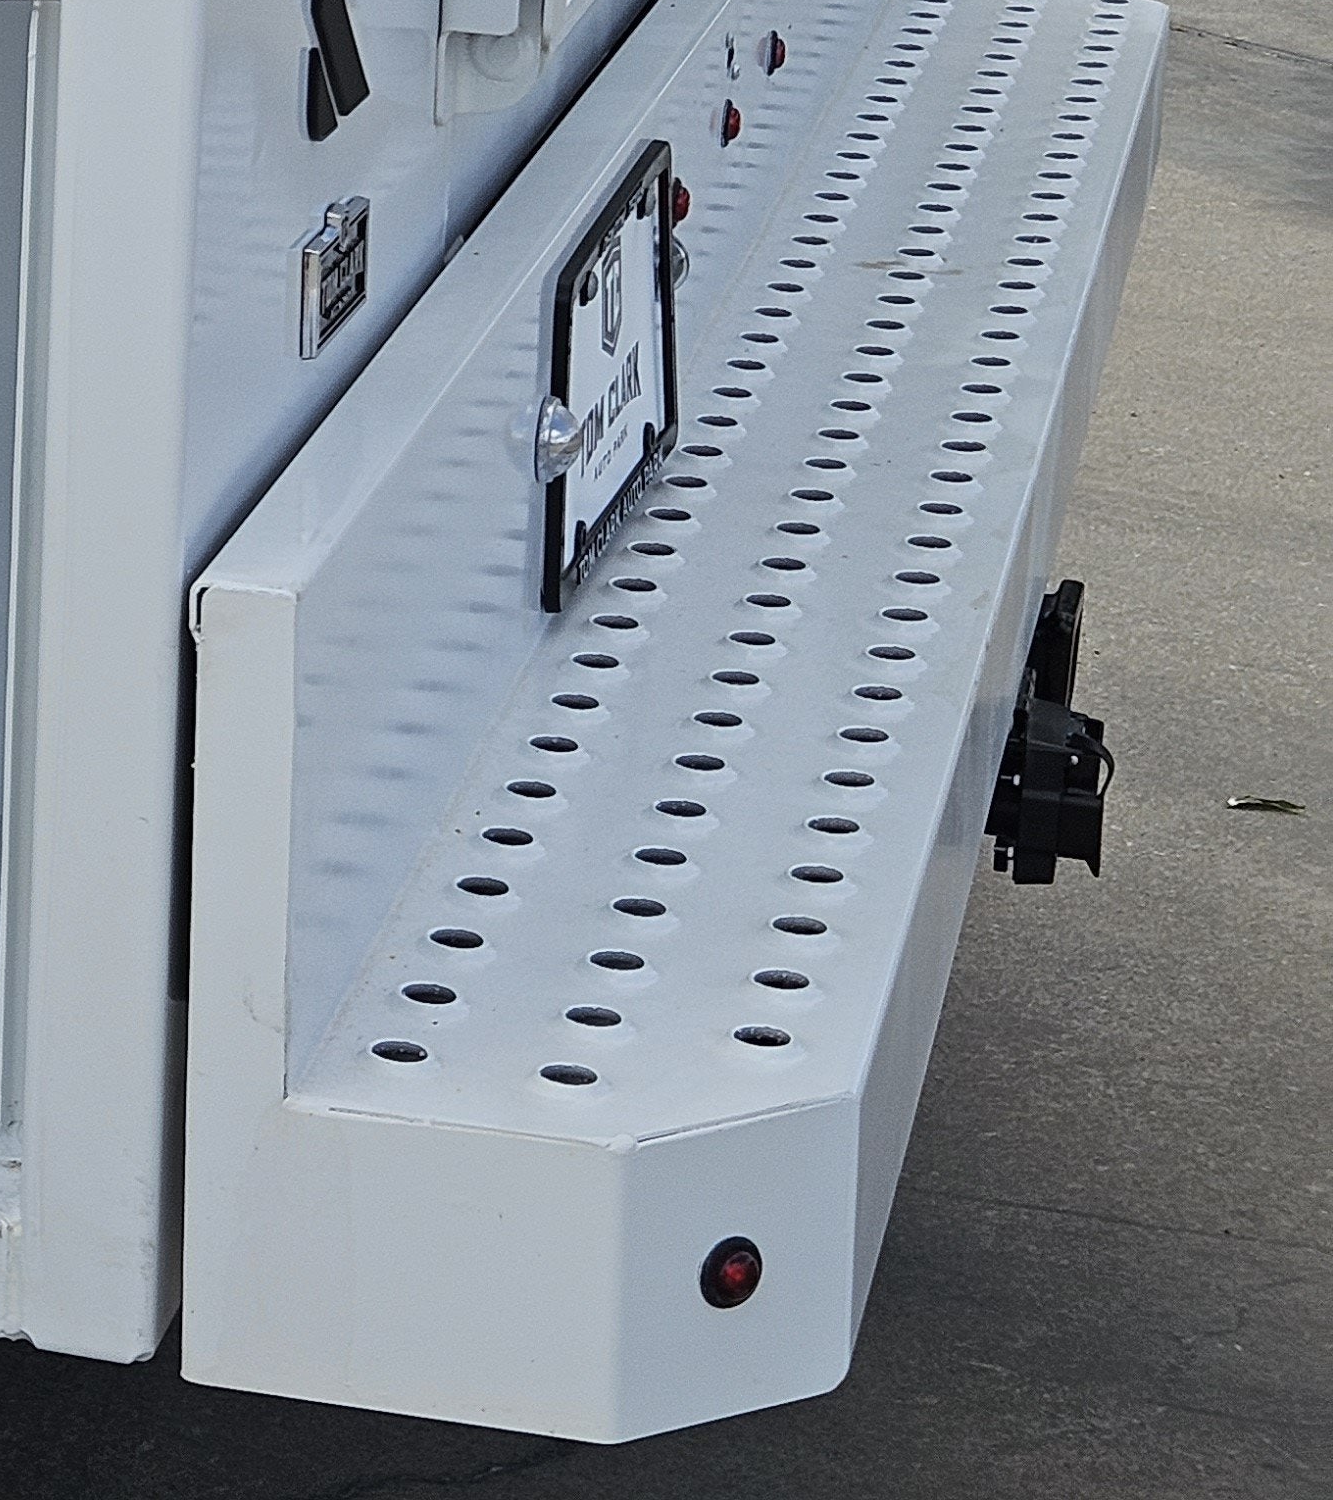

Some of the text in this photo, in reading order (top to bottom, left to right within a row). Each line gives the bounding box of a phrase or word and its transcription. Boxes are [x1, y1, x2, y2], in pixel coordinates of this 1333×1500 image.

[581, 340, 642, 479] TOM CLARK
[594, 422, 628, 481] AUTO PARK
[578, 445, 666, 585] TOM CLARK AUTO PARK
